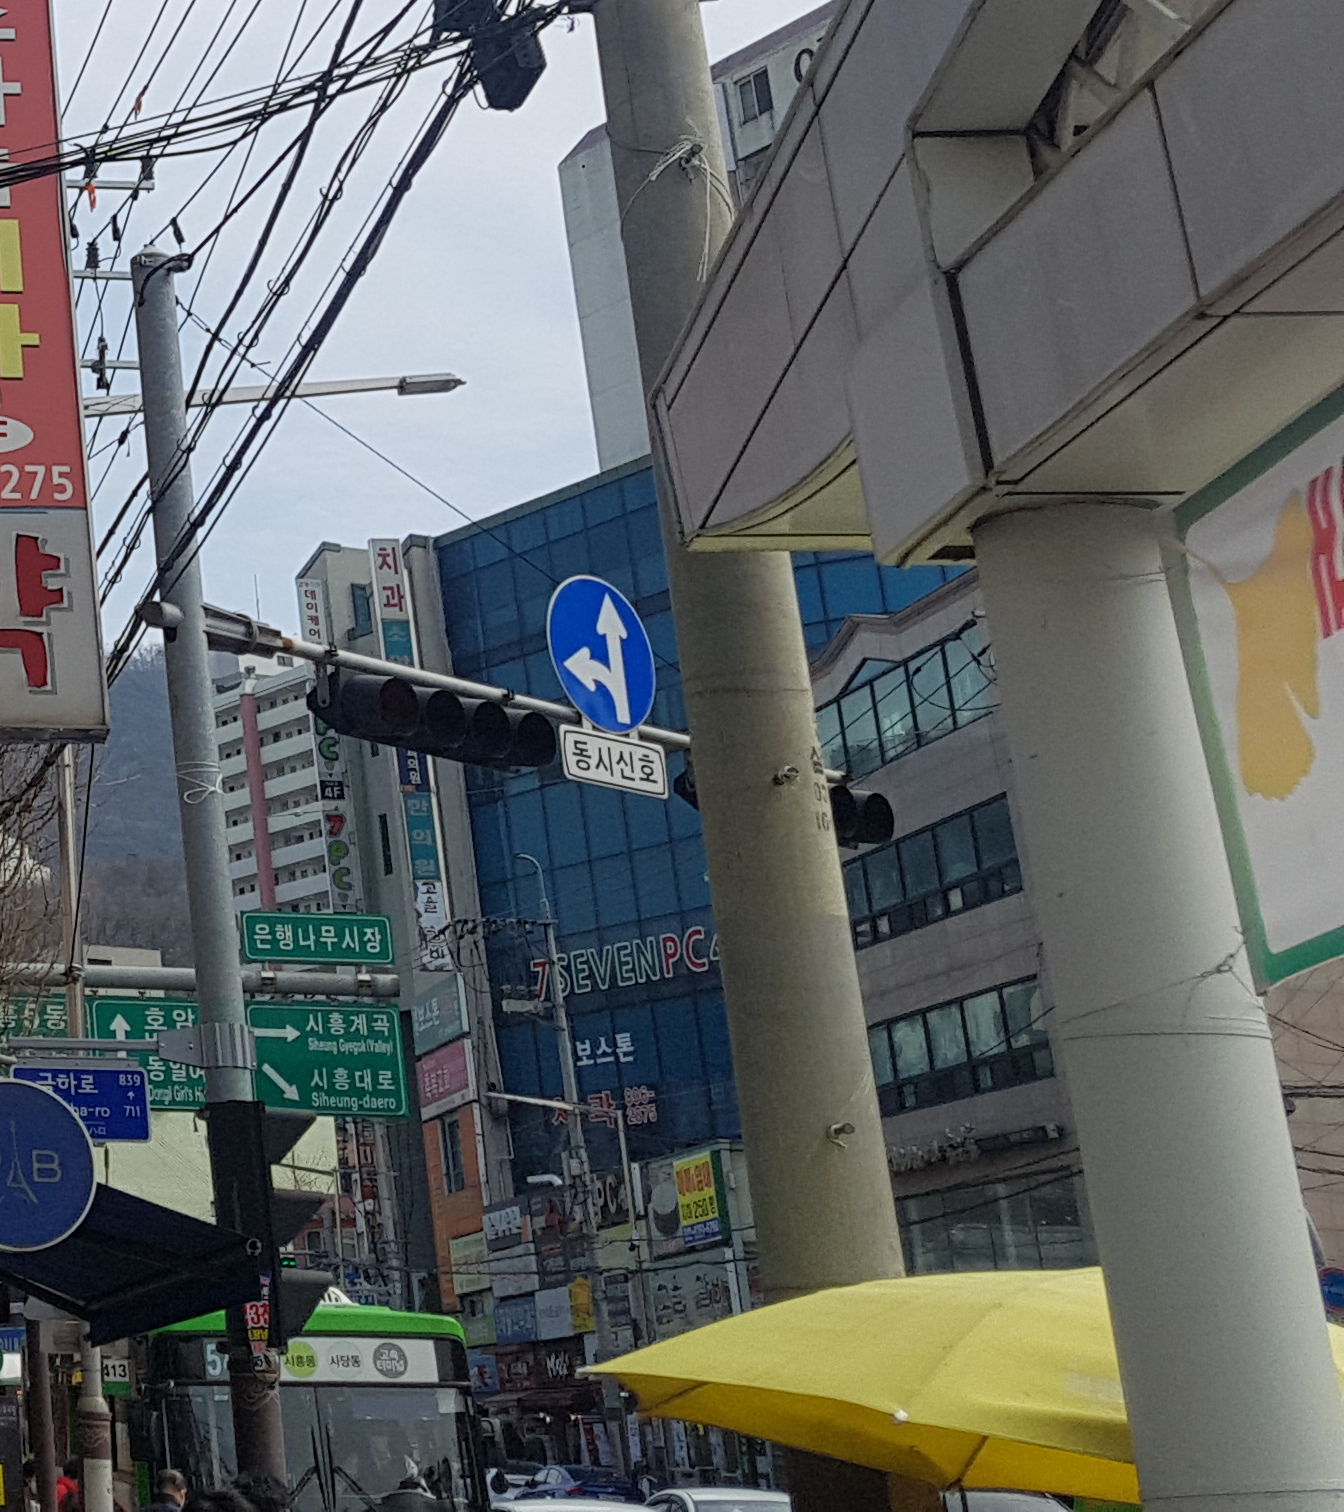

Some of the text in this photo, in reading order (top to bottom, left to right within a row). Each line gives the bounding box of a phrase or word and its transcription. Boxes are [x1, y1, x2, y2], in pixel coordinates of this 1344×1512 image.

[377, 547, 405, 613] 치과
[572, 739, 659, 785] 동시신호
[324, 786, 343, 799] 4F
[253, 923, 382, 954] 은행나무시장
[306, 1011, 391, 1037] 시흥계곡
[574, 1032, 635, 1067] 보스톤
[118, 1074, 141, 1086] 839
[310, 1067, 395, 1092] 시흥대로
[123, 1104, 141, 1117] 711
[311, 1093, 397, 1112] Siheung-daero
[284, 1352, 316, 1368] 시흥동
[328, 1354, 361, 1369] 사당동
